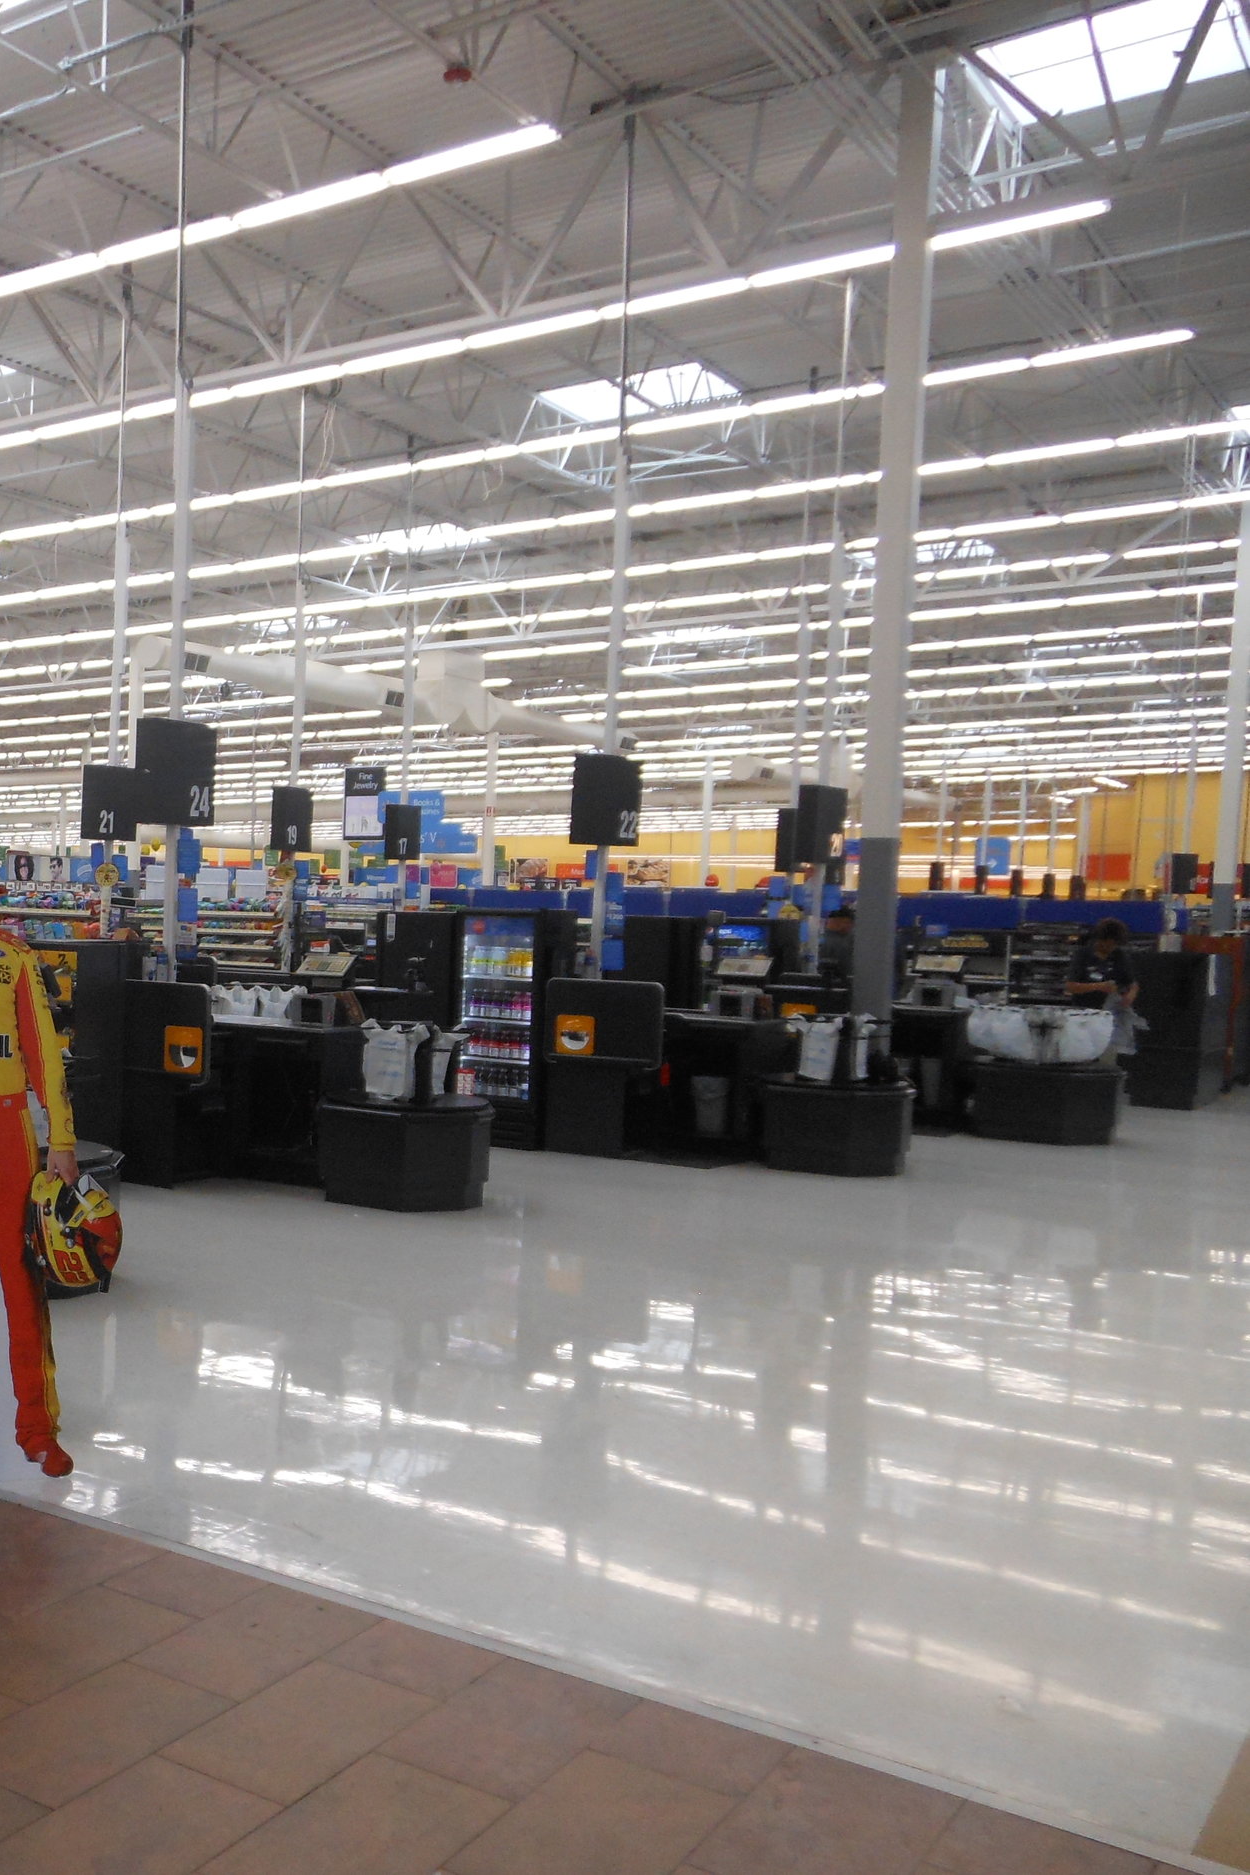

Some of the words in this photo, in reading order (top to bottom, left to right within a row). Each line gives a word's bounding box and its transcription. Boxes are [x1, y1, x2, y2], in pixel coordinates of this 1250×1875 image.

[353, 781, 378, 790] Jewelry
[358, 772, 373, 780] Fine
[190, 785, 210, 818] 24
[99, 809, 114, 834] 21
[620, 810, 637, 838] 22
[287, 825, 297, 845] 19
[830, 833, 843, 857] 20
[399, 838, 407, 855] 17
